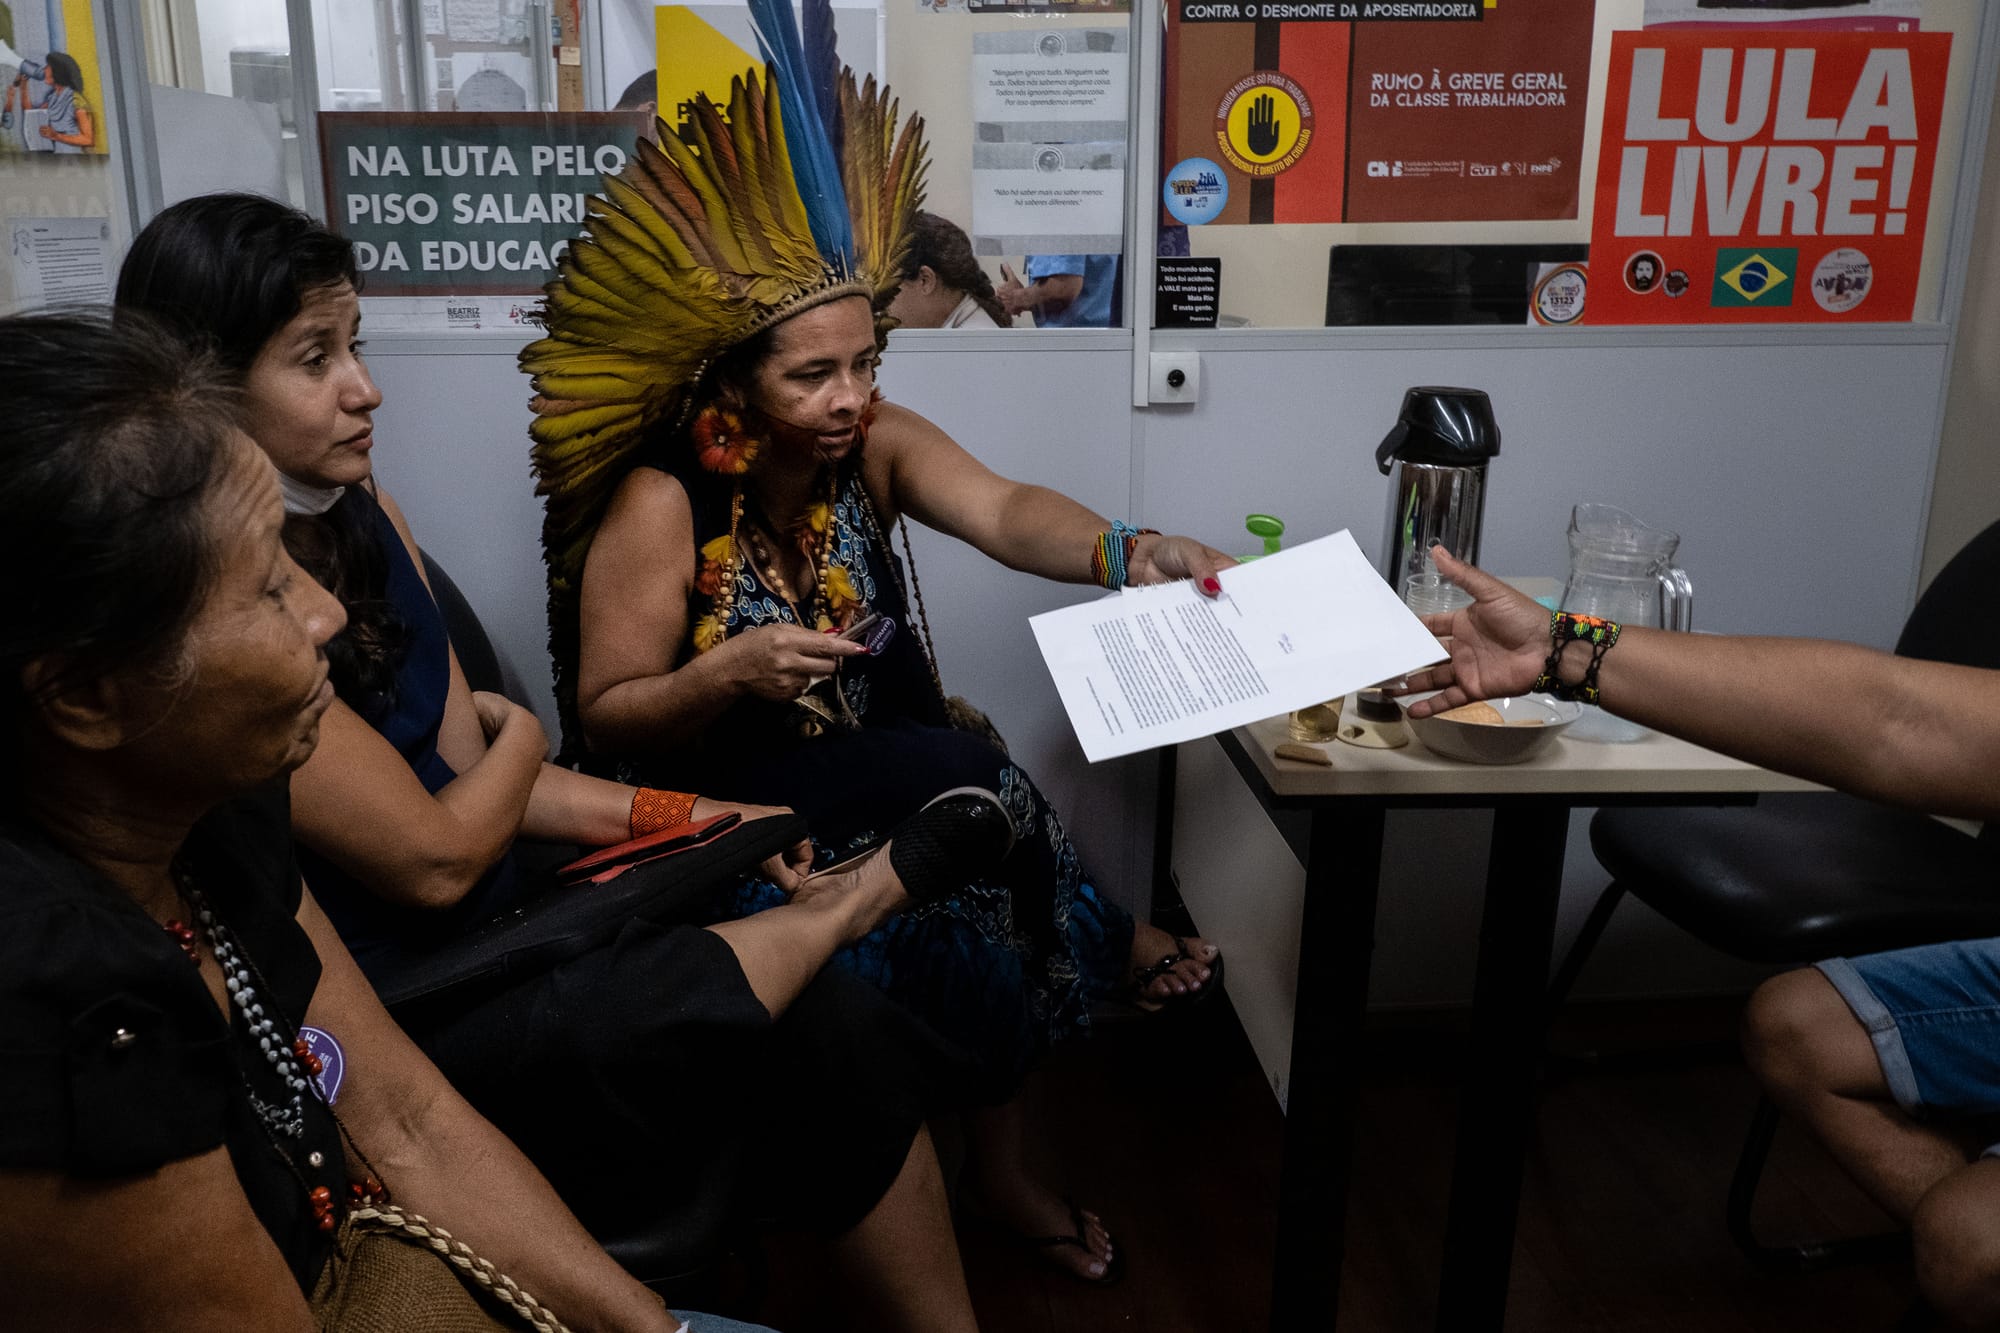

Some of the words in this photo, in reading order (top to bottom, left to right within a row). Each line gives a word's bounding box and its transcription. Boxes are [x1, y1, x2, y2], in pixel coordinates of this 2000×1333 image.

[1186, 4, 1240, 18] CONTRA
[1245, 4, 1257, 17] O
[1262, 4, 1335, 17] DESMONTE
[1340, 4, 1358, 17] DA
[1364, 4, 1477, 17] APOSENTADORIA
[1371, 73, 1423, 90] RUMO
[1430, 68, 1441, 89] À
[1449, 73, 1504, 90] GREVE
[1512, 73, 1567, 90] GERAL
[1235, 76, 1257, 94] NASCE
[1267, 74, 1285, 86] PARA
[1284, 81, 1312, 118] TRABALHAR
[1370, 93, 1389, 107] DA
[1396, 93, 1449, 107] CLASSE
[1456, 92, 1566, 106] TRABALHADORA
[1624, 48, 1918, 142] LULA
[347, 145, 410, 177] NA
[422, 145, 519, 177] LUTA
[531, 144, 627, 177] PELO
[1260, 161, 1286, 176] DIREITO
[1471, 166, 1493, 176] CUT
[1614, 145, 1917, 237] LIVRE!
[346, 193, 439, 225] PISO
[451, 193, 609, 225] SALARI
[351, 241, 410, 271] DA
[447, 307, 480, 315] BEATRIZ
[1549, 296, 1575, 305] 13123
